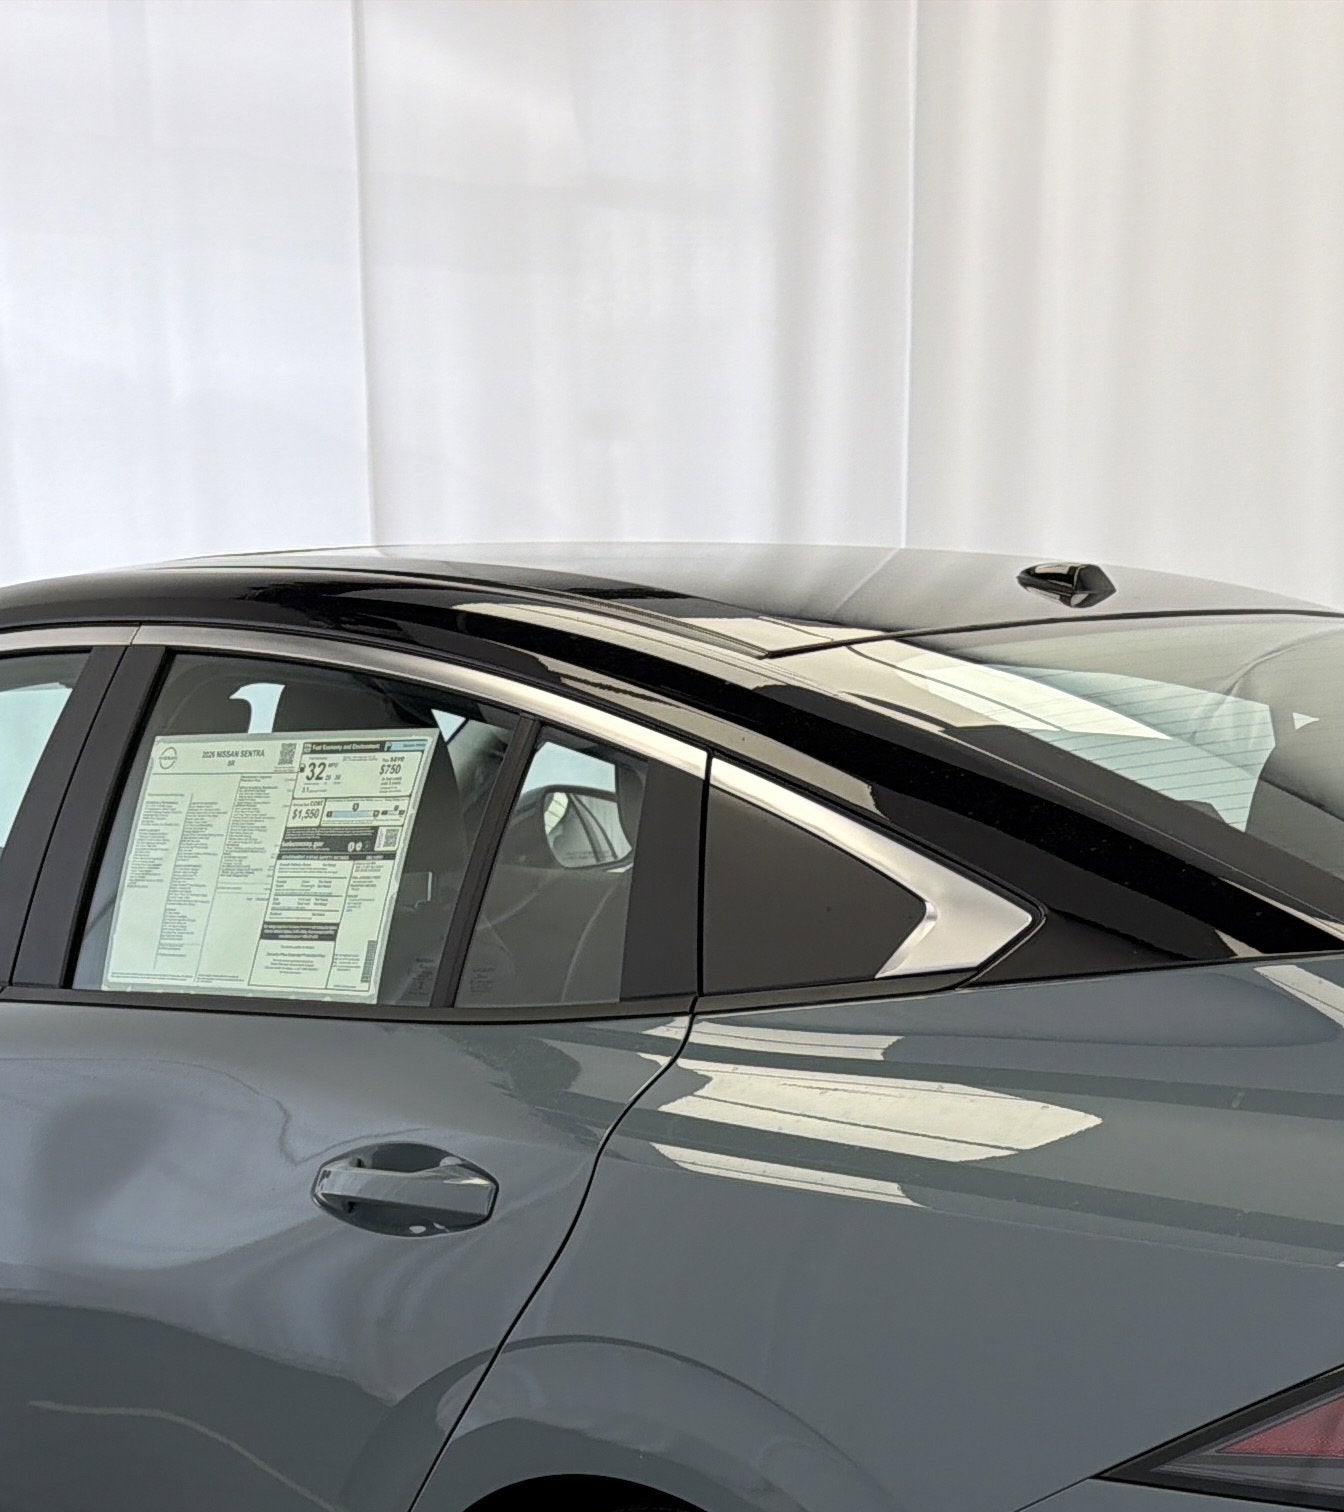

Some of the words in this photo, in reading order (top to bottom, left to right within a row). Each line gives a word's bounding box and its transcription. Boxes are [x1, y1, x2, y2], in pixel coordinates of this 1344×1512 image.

[216, 750, 239, 758] NISSAN
[240, 749, 265, 757] SENTRA
[306, 762, 327, 781] 32
[379, 763, 402, 775] $750
[292, 808, 320, 821] $1,550
